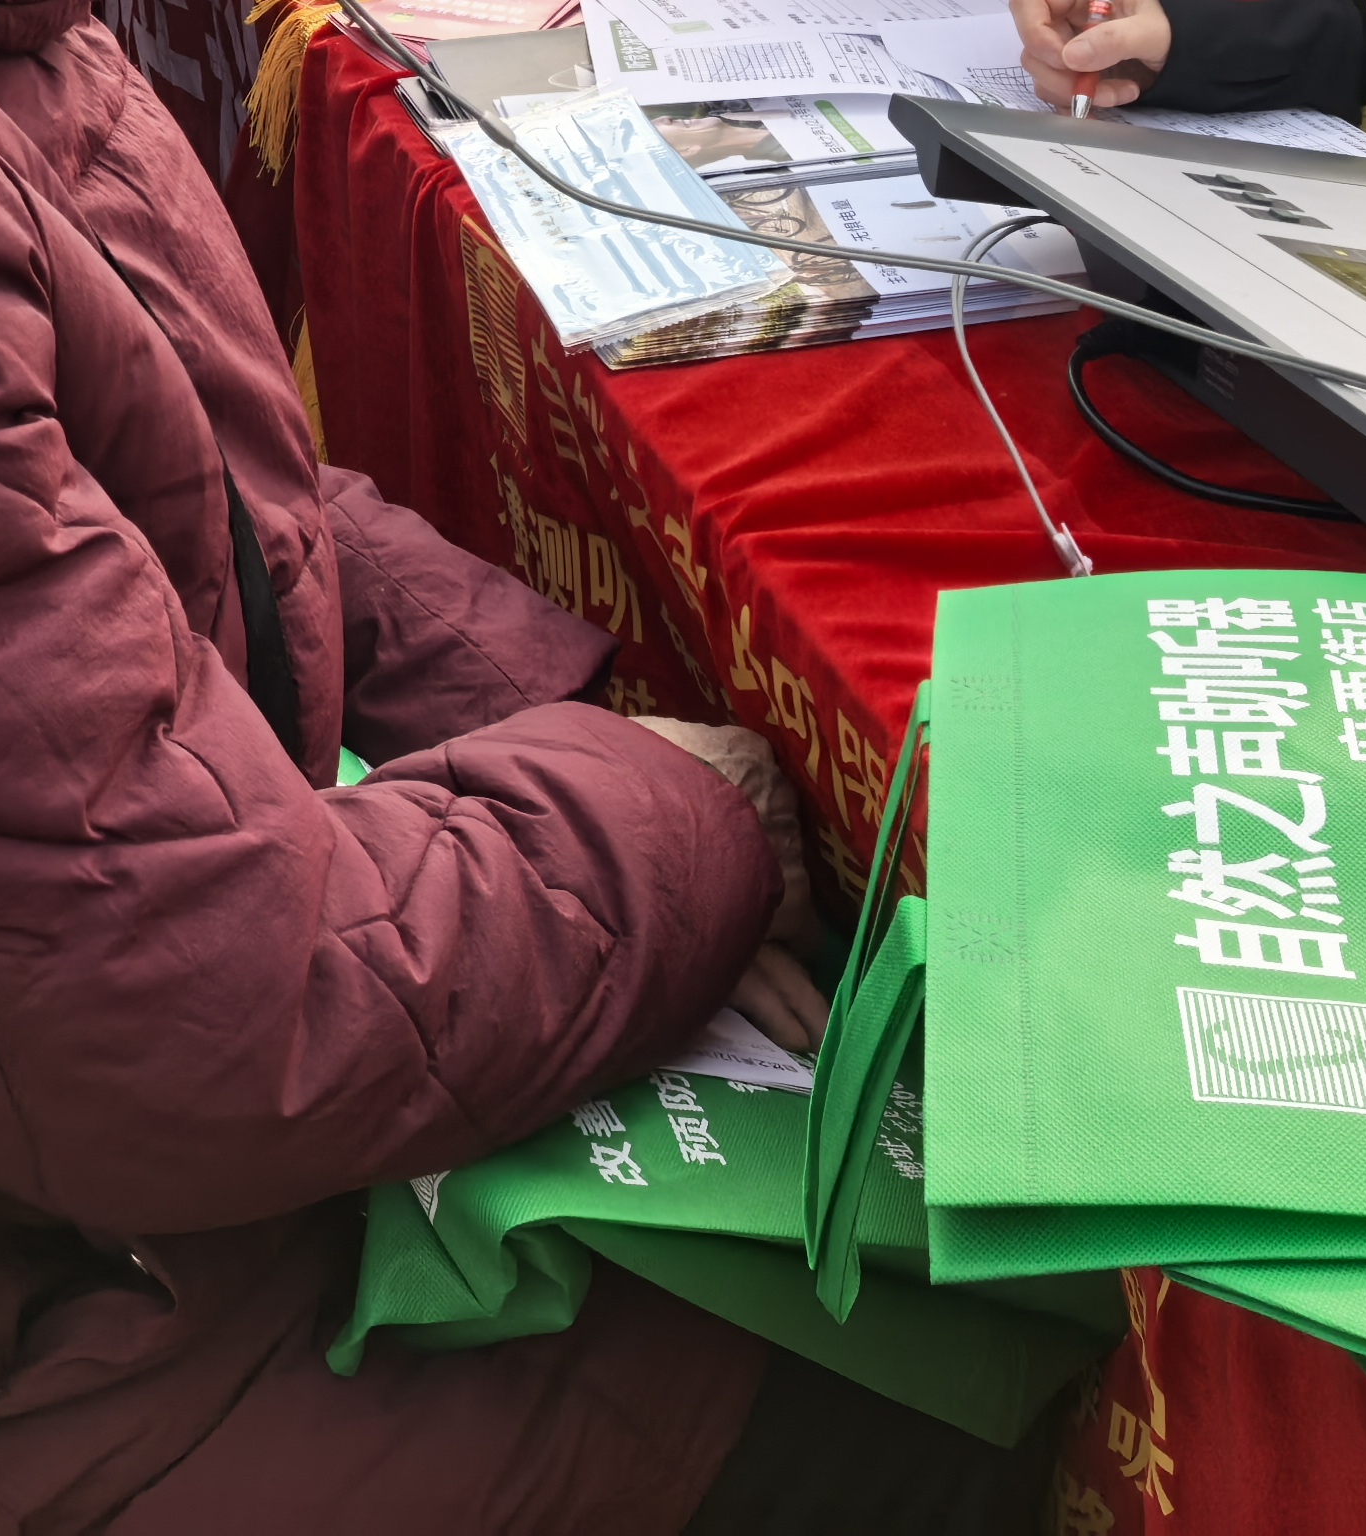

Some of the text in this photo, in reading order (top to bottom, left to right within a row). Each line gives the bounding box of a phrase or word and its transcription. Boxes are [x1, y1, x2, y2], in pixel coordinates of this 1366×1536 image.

[1146, 597, 1355, 980] 自然之声助听器
[649, 1068, 727, 1167] 预防
